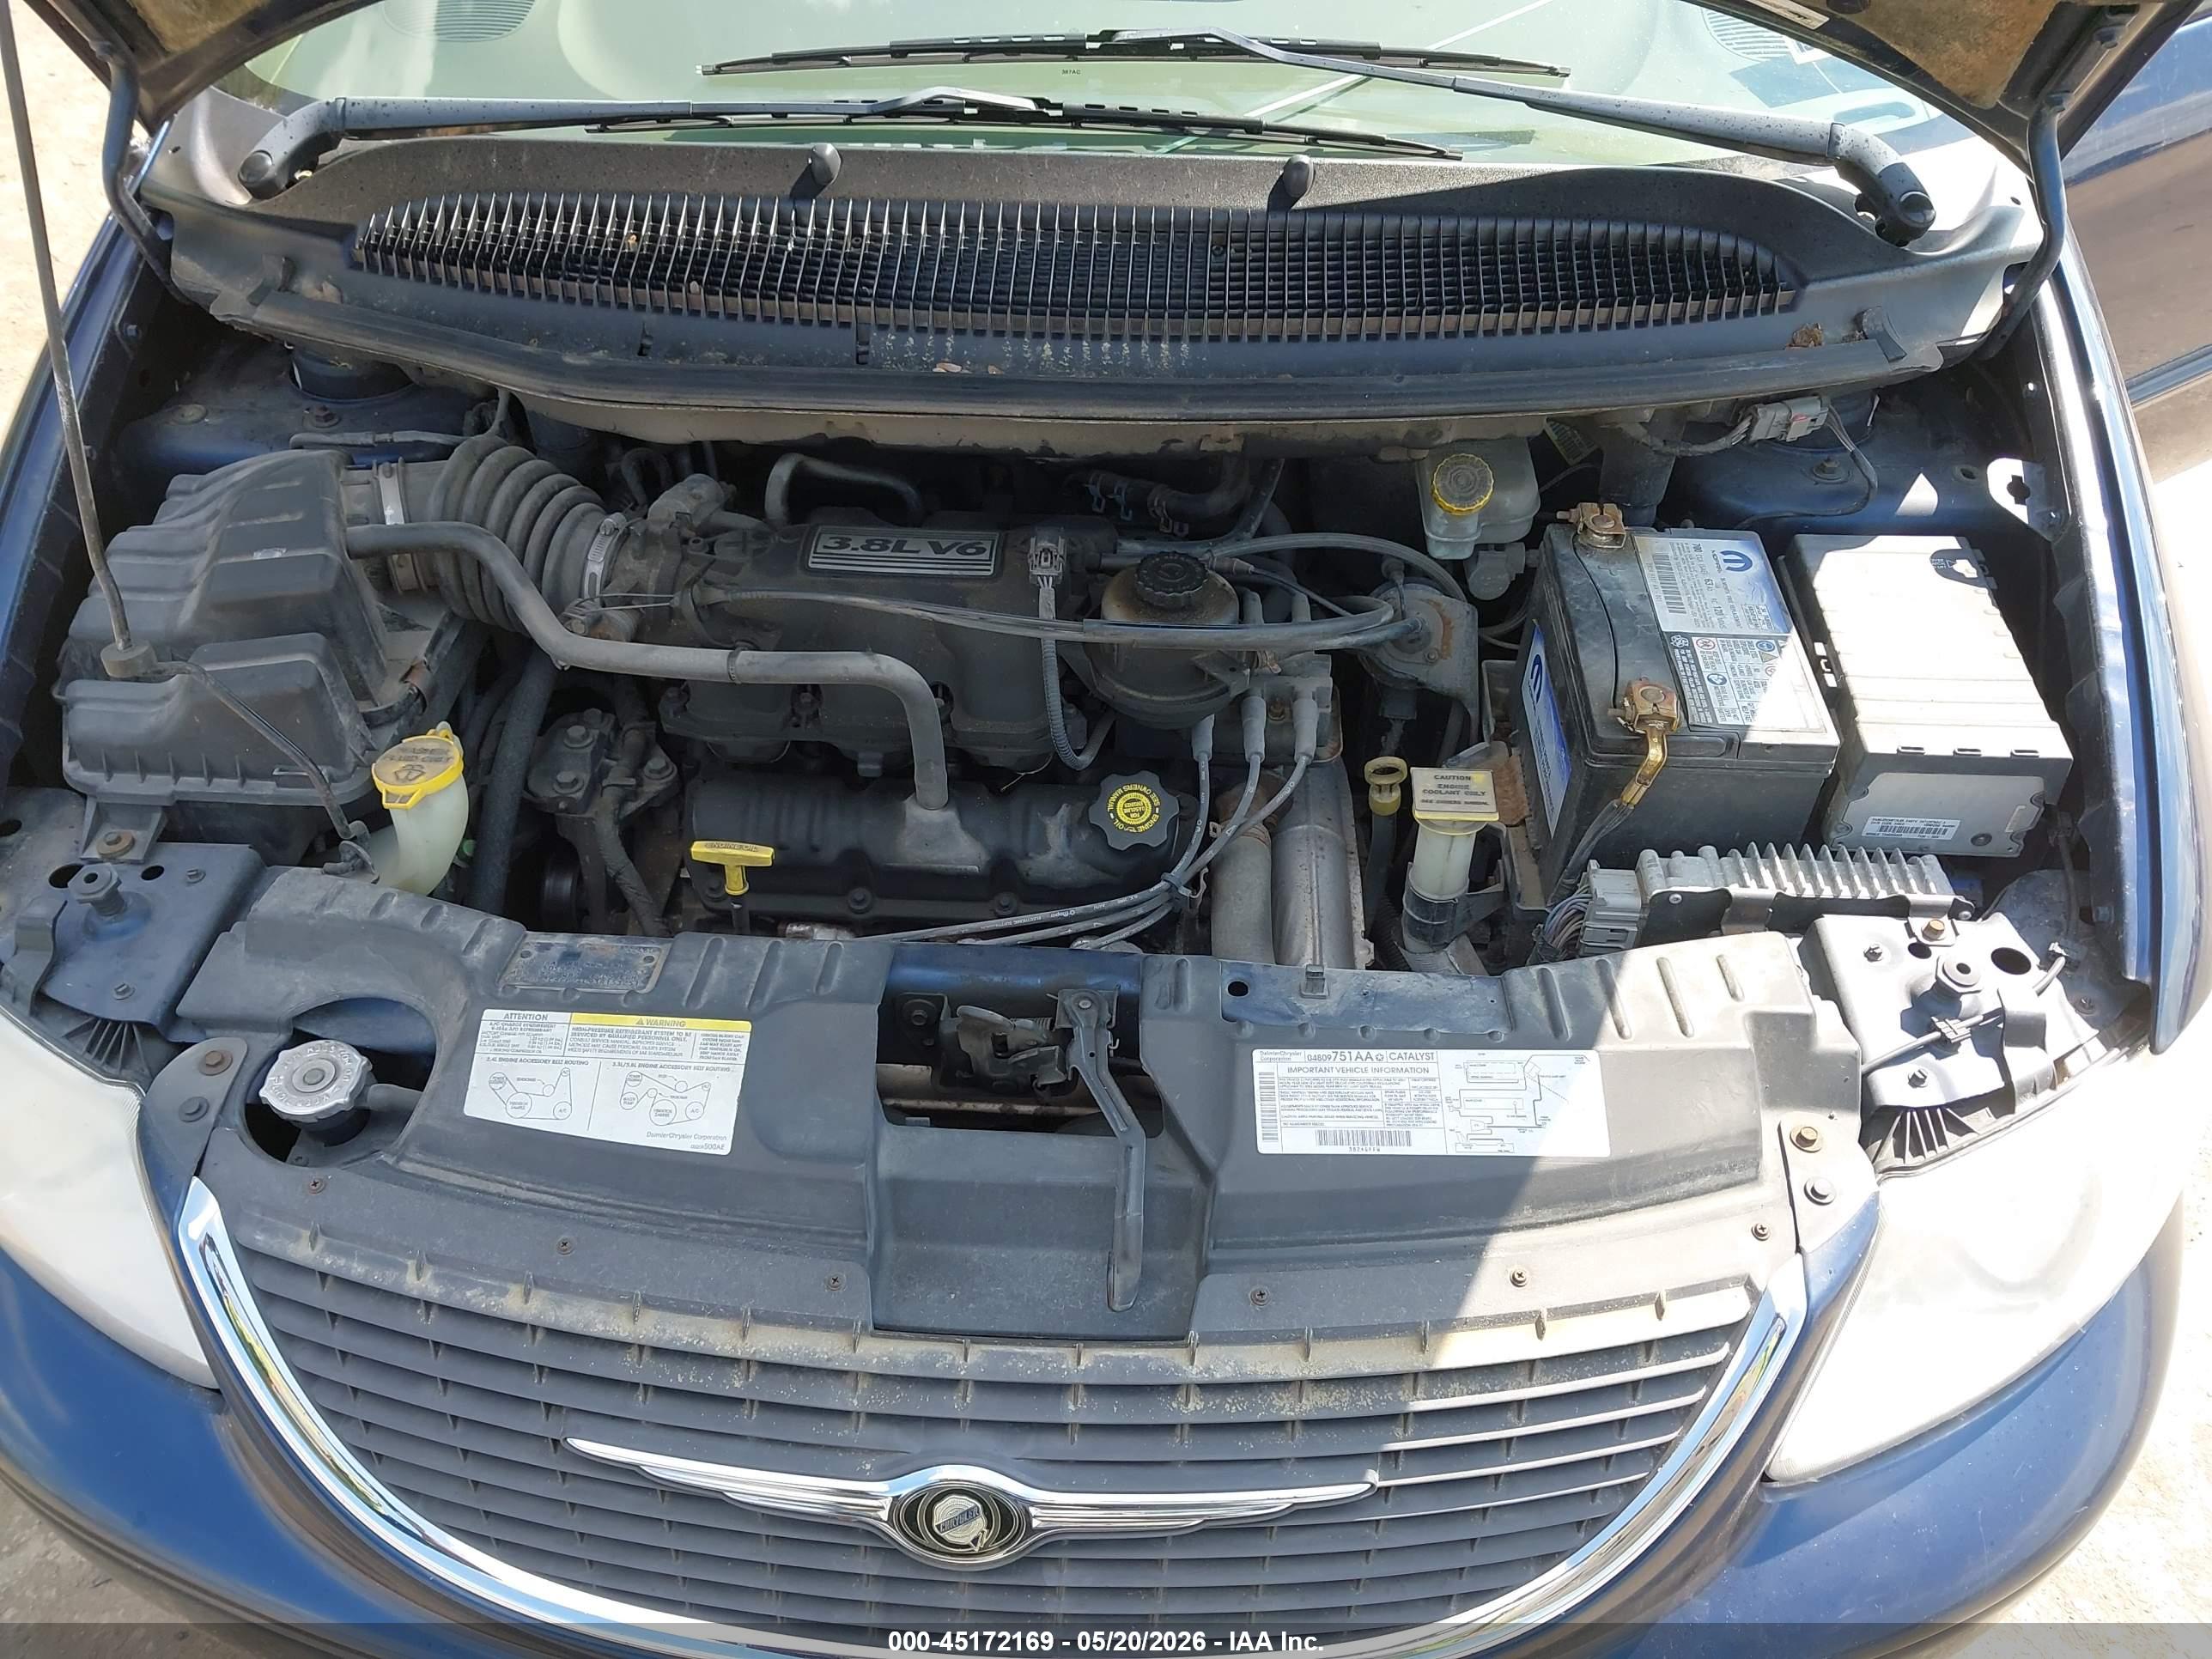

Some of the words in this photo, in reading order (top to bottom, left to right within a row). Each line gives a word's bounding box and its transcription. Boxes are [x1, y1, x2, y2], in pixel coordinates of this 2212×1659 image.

[823, 536, 921, 554] 3.8L
[927, 540, 987, 556] V6
[1122, 783, 1152, 795] OWNERS
[1150, 792, 1161, 807] SEE
[1113, 818, 1124, 830] OIL
[503, 1012, 548, 1021] ATTENTION
[644, 1018, 687, 1027] WARNING
[1307, 1051, 1374, 1062] 04809751AA
[1389, 1052, 1435, 1061] CATALYST
[646, 1131, 693, 1141] DaimlerChrysler
[939, 1506, 980, 1533] CHRYSLER
